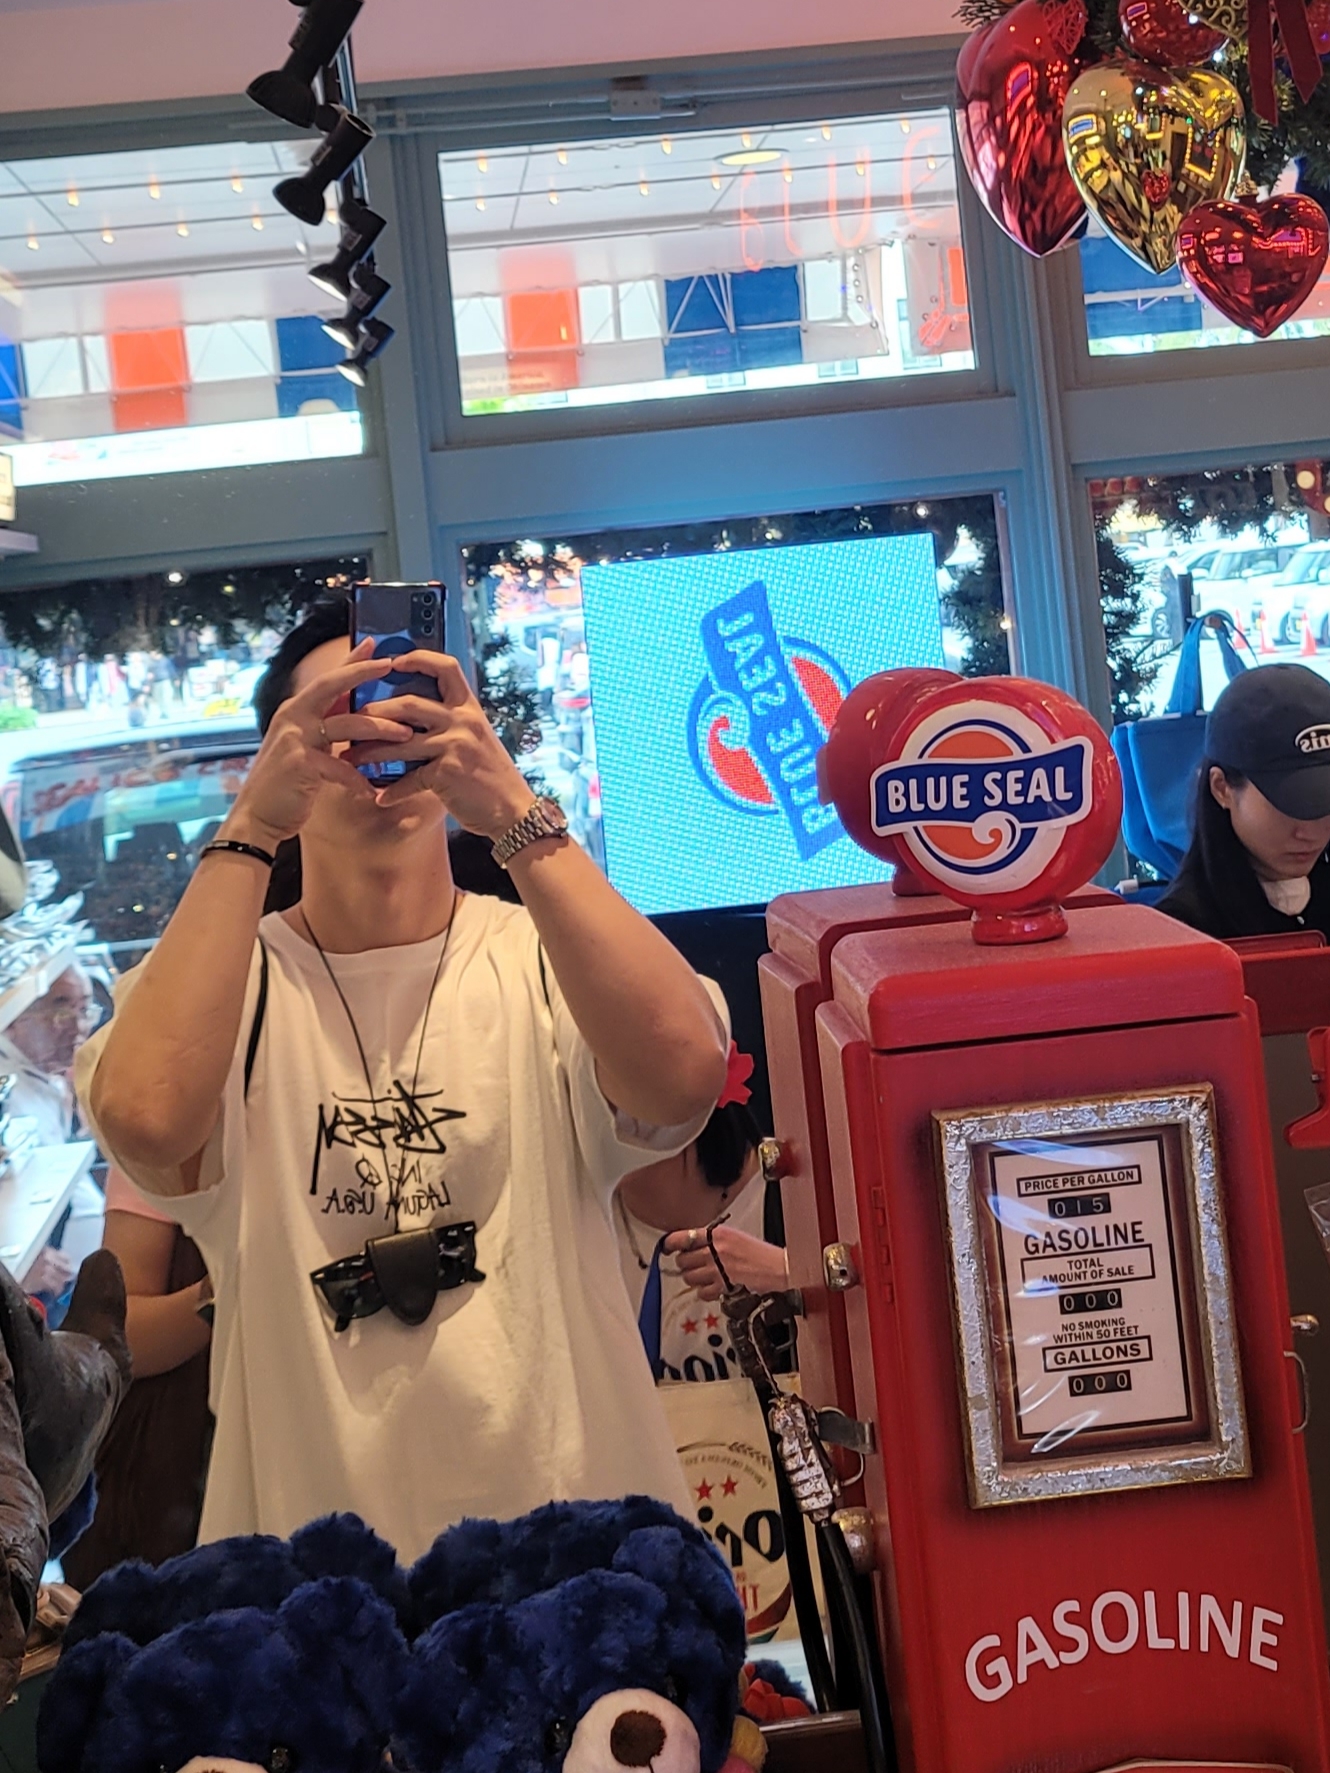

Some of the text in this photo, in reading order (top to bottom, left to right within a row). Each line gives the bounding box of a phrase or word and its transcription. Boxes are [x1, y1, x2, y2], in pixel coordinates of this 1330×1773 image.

[887, 766, 1074, 813] BLUE SEAL
[1024, 1170, 1134, 1192] PRICE PER GALLON
[1023, 1220, 1145, 1255] GASOLINE
[1041, 1265, 1135, 1284] AMOUNT OF SALE
[1066, 1257, 1104, 1271] TOTAL
[1052, 1325, 1140, 1344] WITHIN 50 FEET
[1061, 1317, 1126, 1332] NO SMOKING
[1053, 1342, 1141, 1366] GALLONS
[964, 1589, 1285, 1703] GASOLINE
